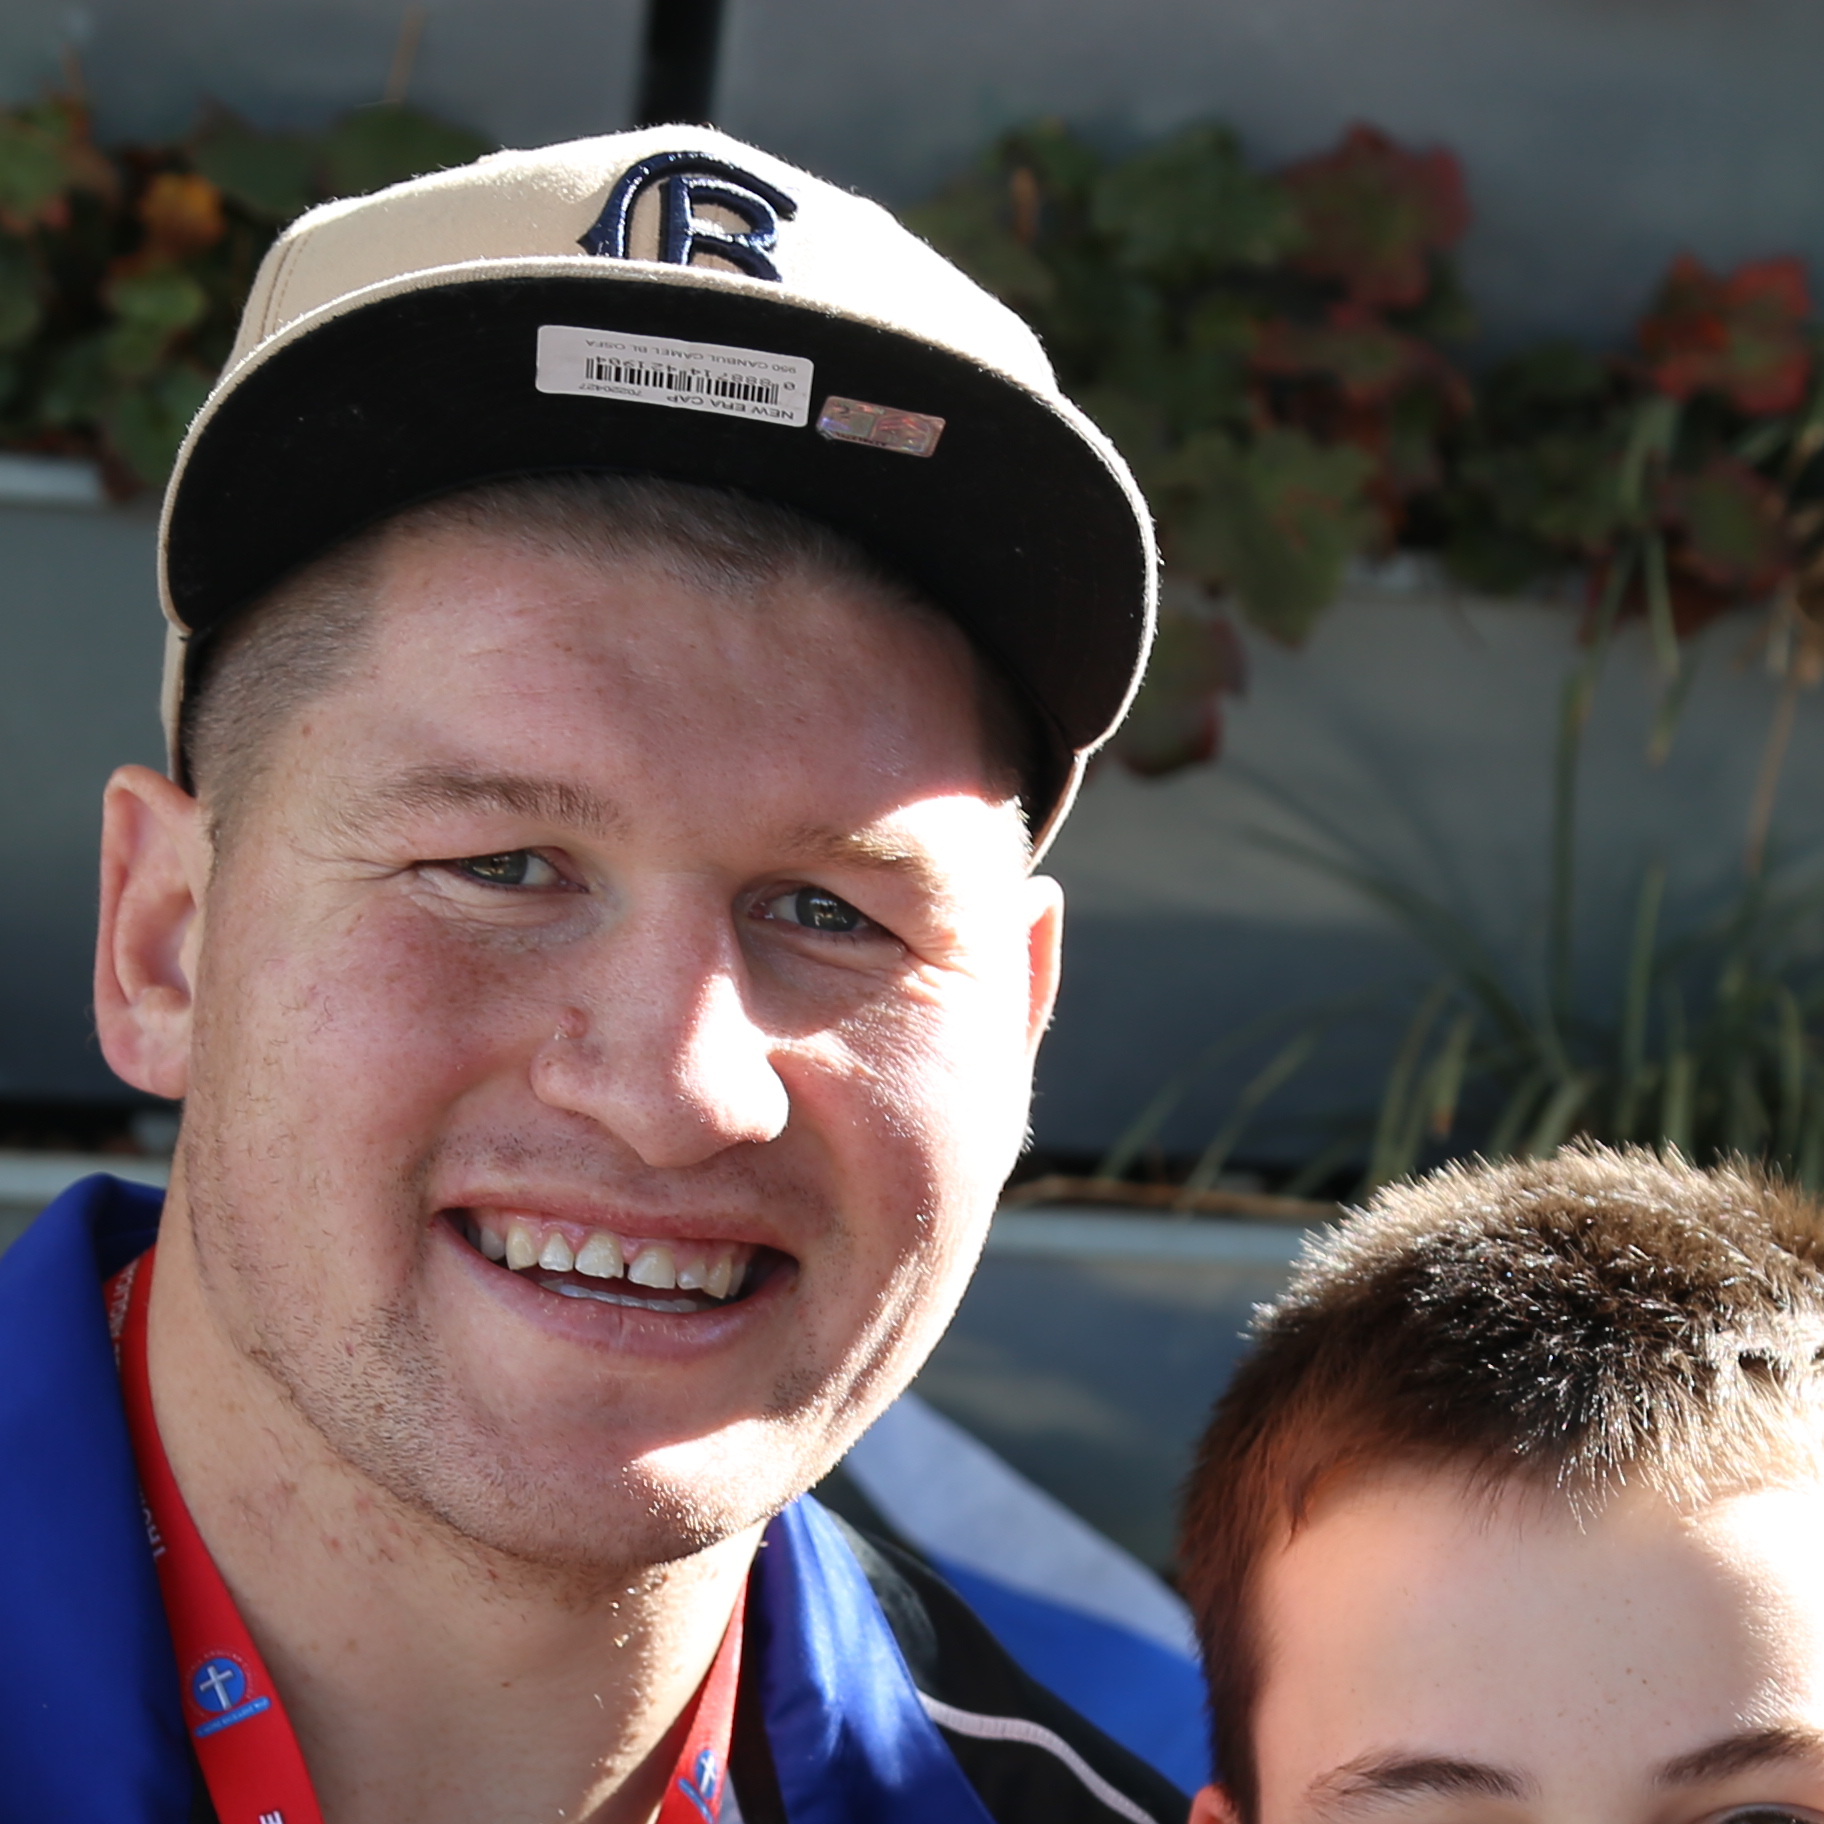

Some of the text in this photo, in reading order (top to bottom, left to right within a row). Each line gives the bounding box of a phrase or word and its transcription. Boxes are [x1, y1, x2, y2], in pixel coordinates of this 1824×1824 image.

[652, 346, 704, 360] CAMEL
[783, 381, 796, 391] 0
[666, 394, 704, 405] CAP
[710, 399, 747, 412] ERA
[752, 405, 795, 420] NEW
